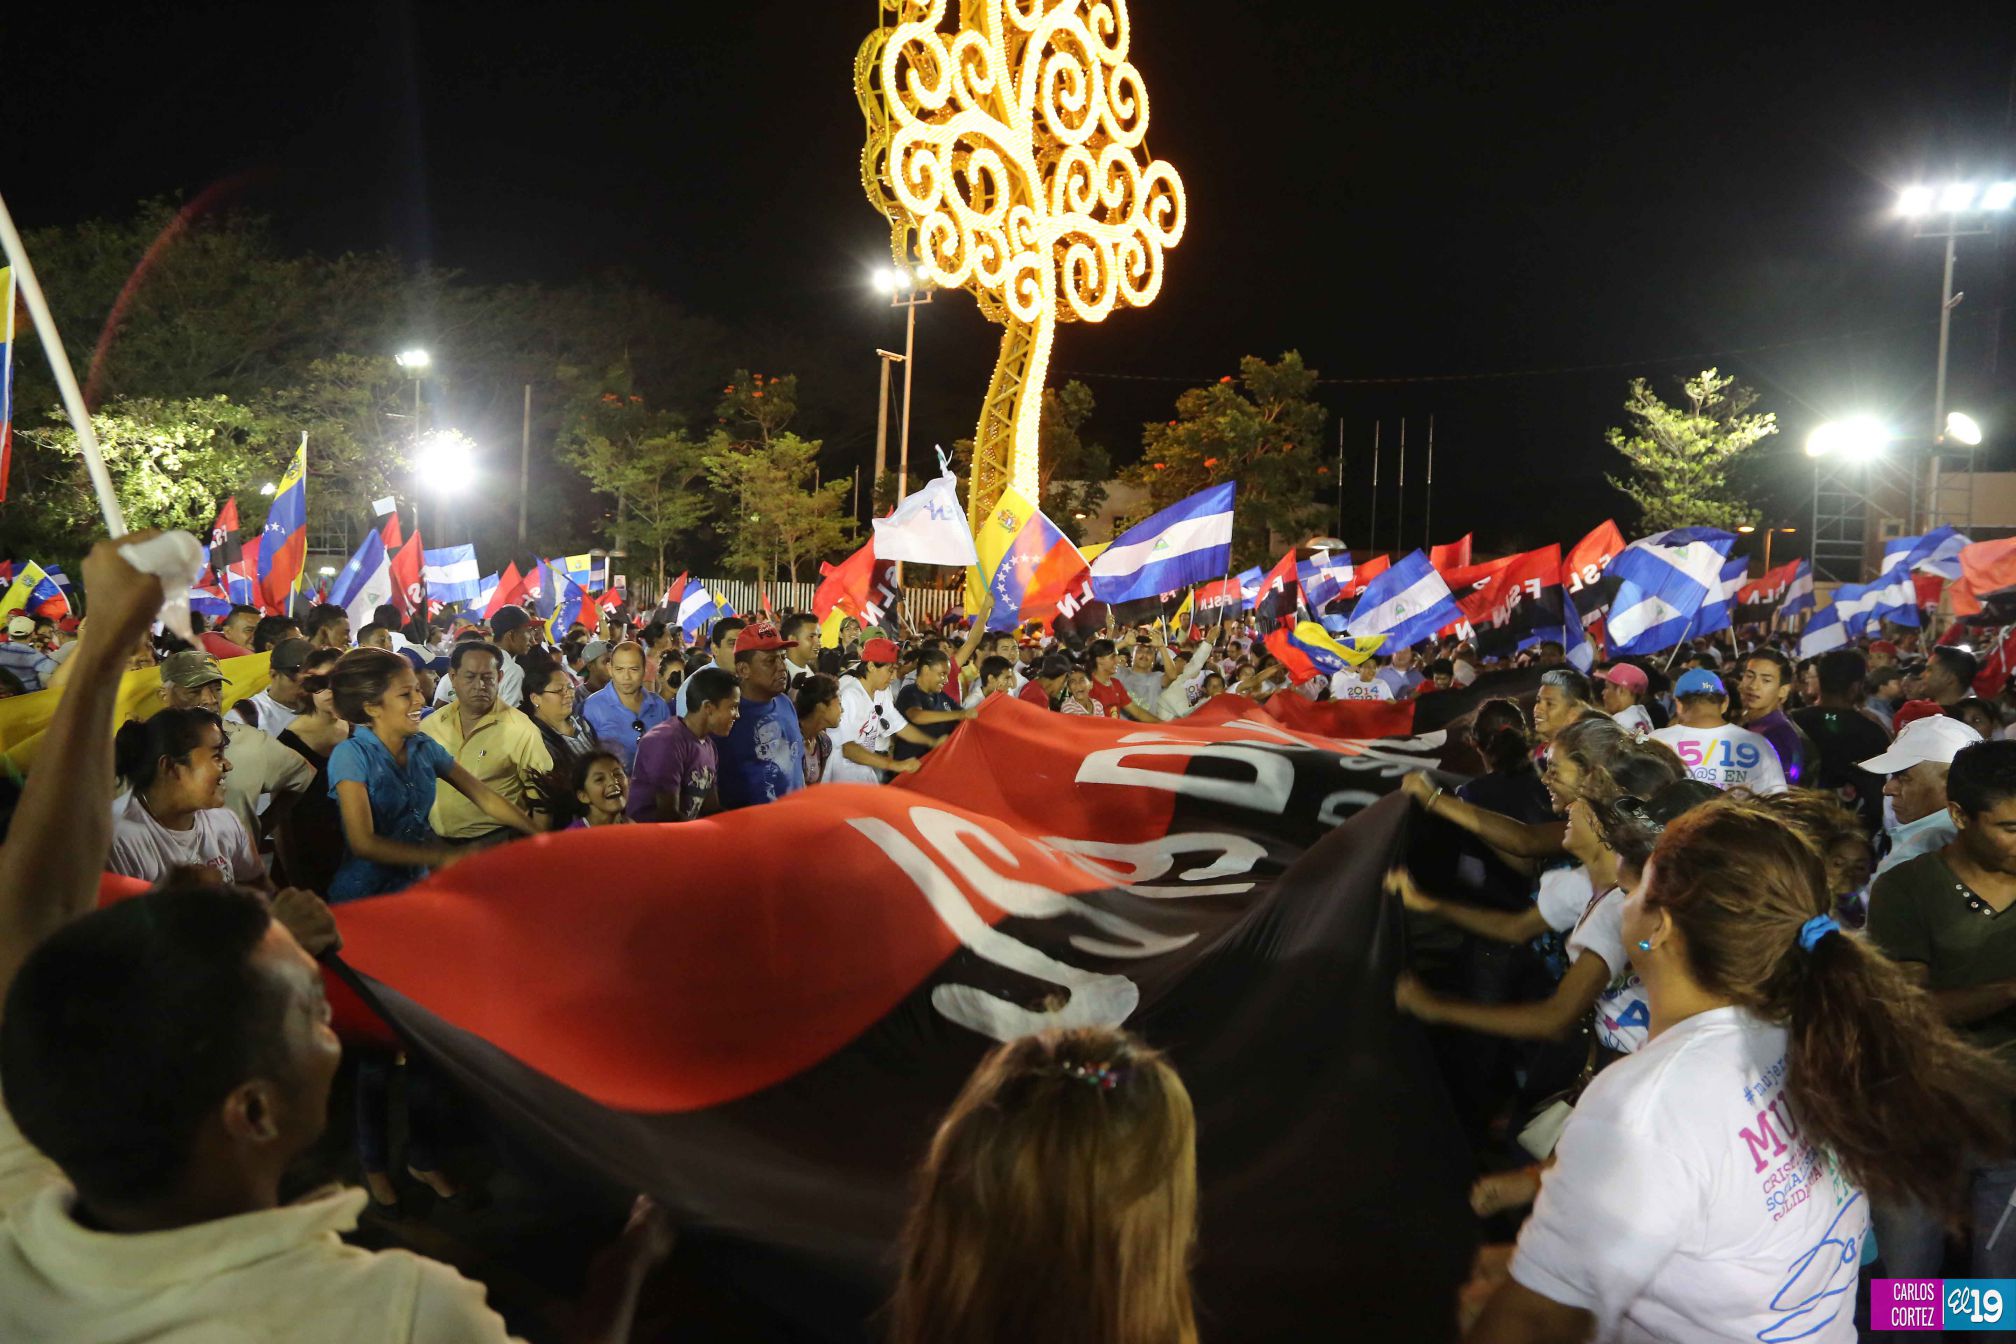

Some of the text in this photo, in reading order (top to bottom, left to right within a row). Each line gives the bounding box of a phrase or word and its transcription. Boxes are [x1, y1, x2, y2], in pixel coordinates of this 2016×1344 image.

[1347, 686, 1379, 696] 2014
[1677, 738, 1760, 768] 5/19
[1724, 769, 1748, 783] EN
[1743, 1056, 1788, 1105] #mujer
